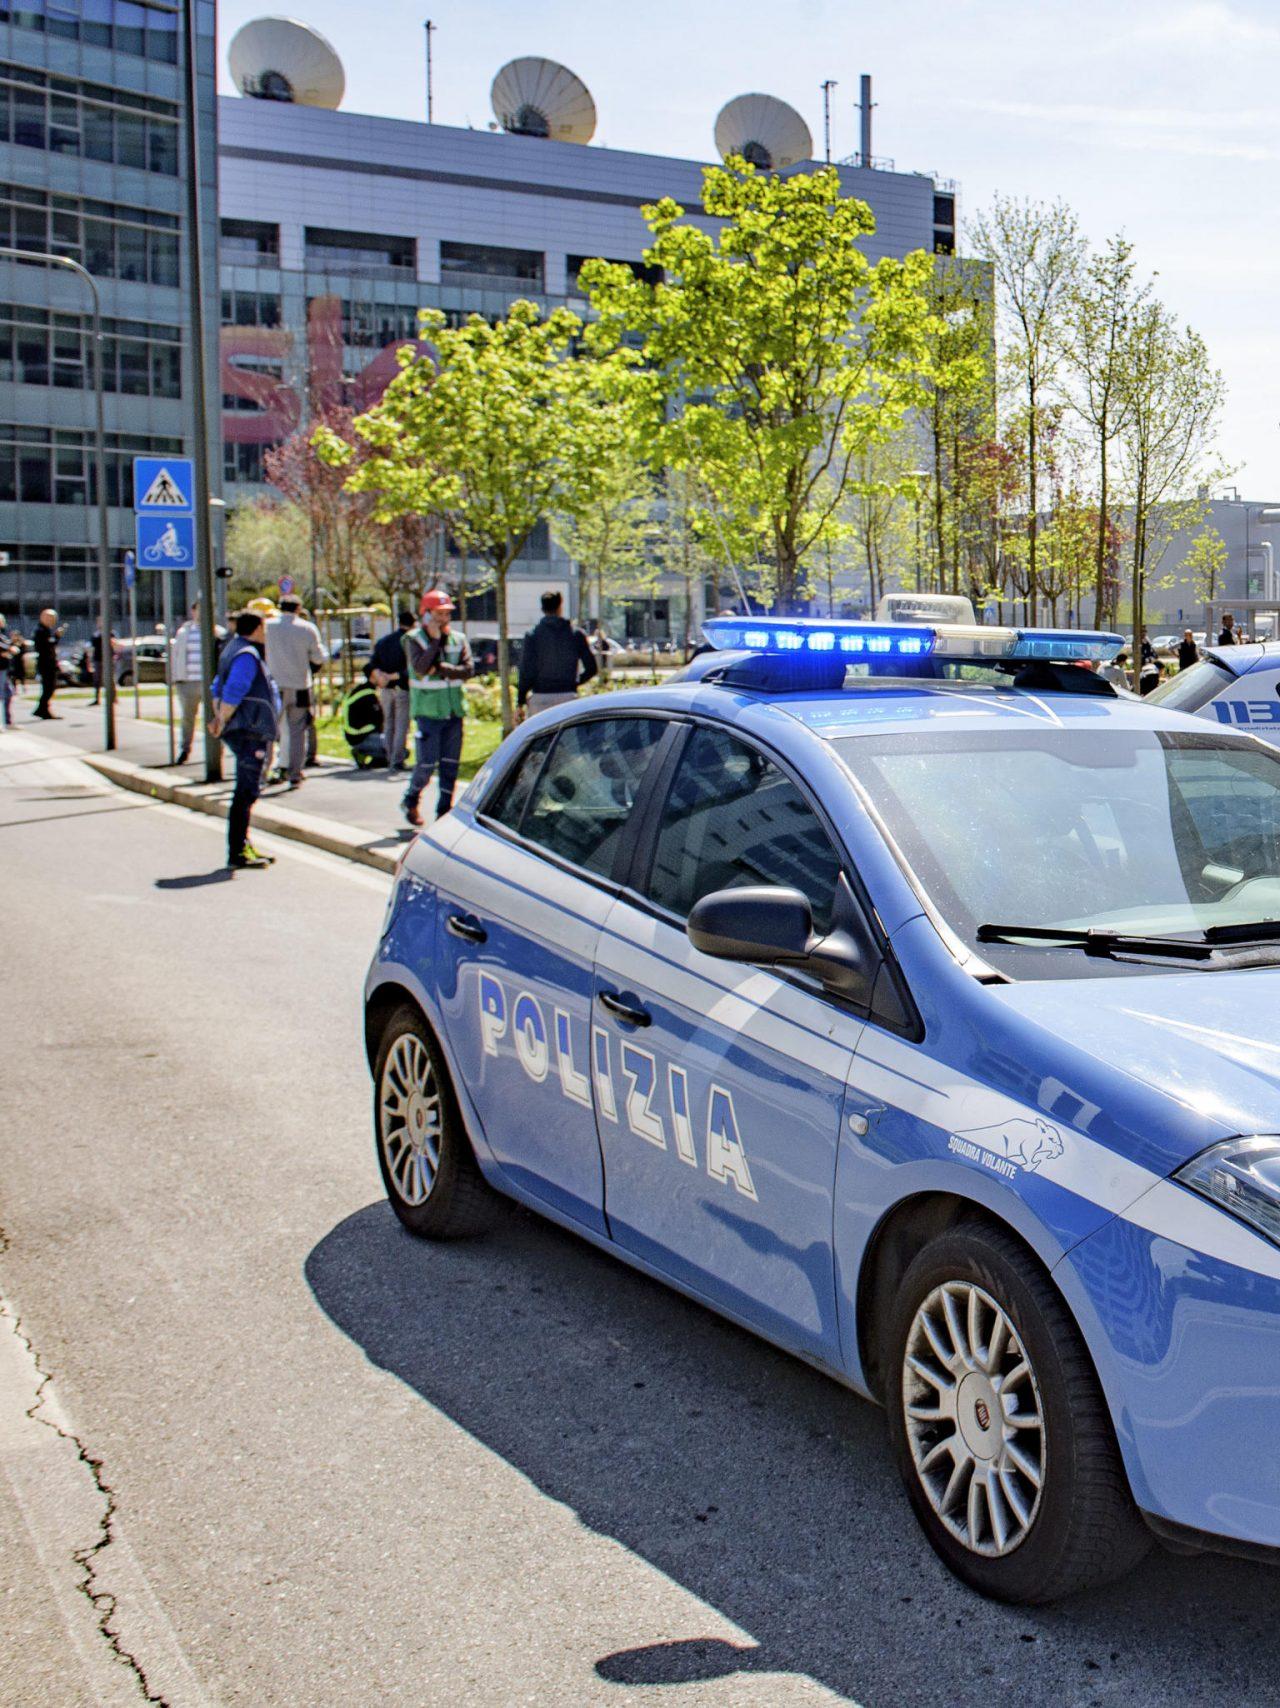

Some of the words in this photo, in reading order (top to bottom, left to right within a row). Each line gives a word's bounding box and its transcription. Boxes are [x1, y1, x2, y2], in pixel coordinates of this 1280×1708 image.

[478, 968, 759, 1202] POLIZIA
[947, 1135, 981, 1162] SQUADRA
[982, 1151, 1018, 1179] VOLANTE
